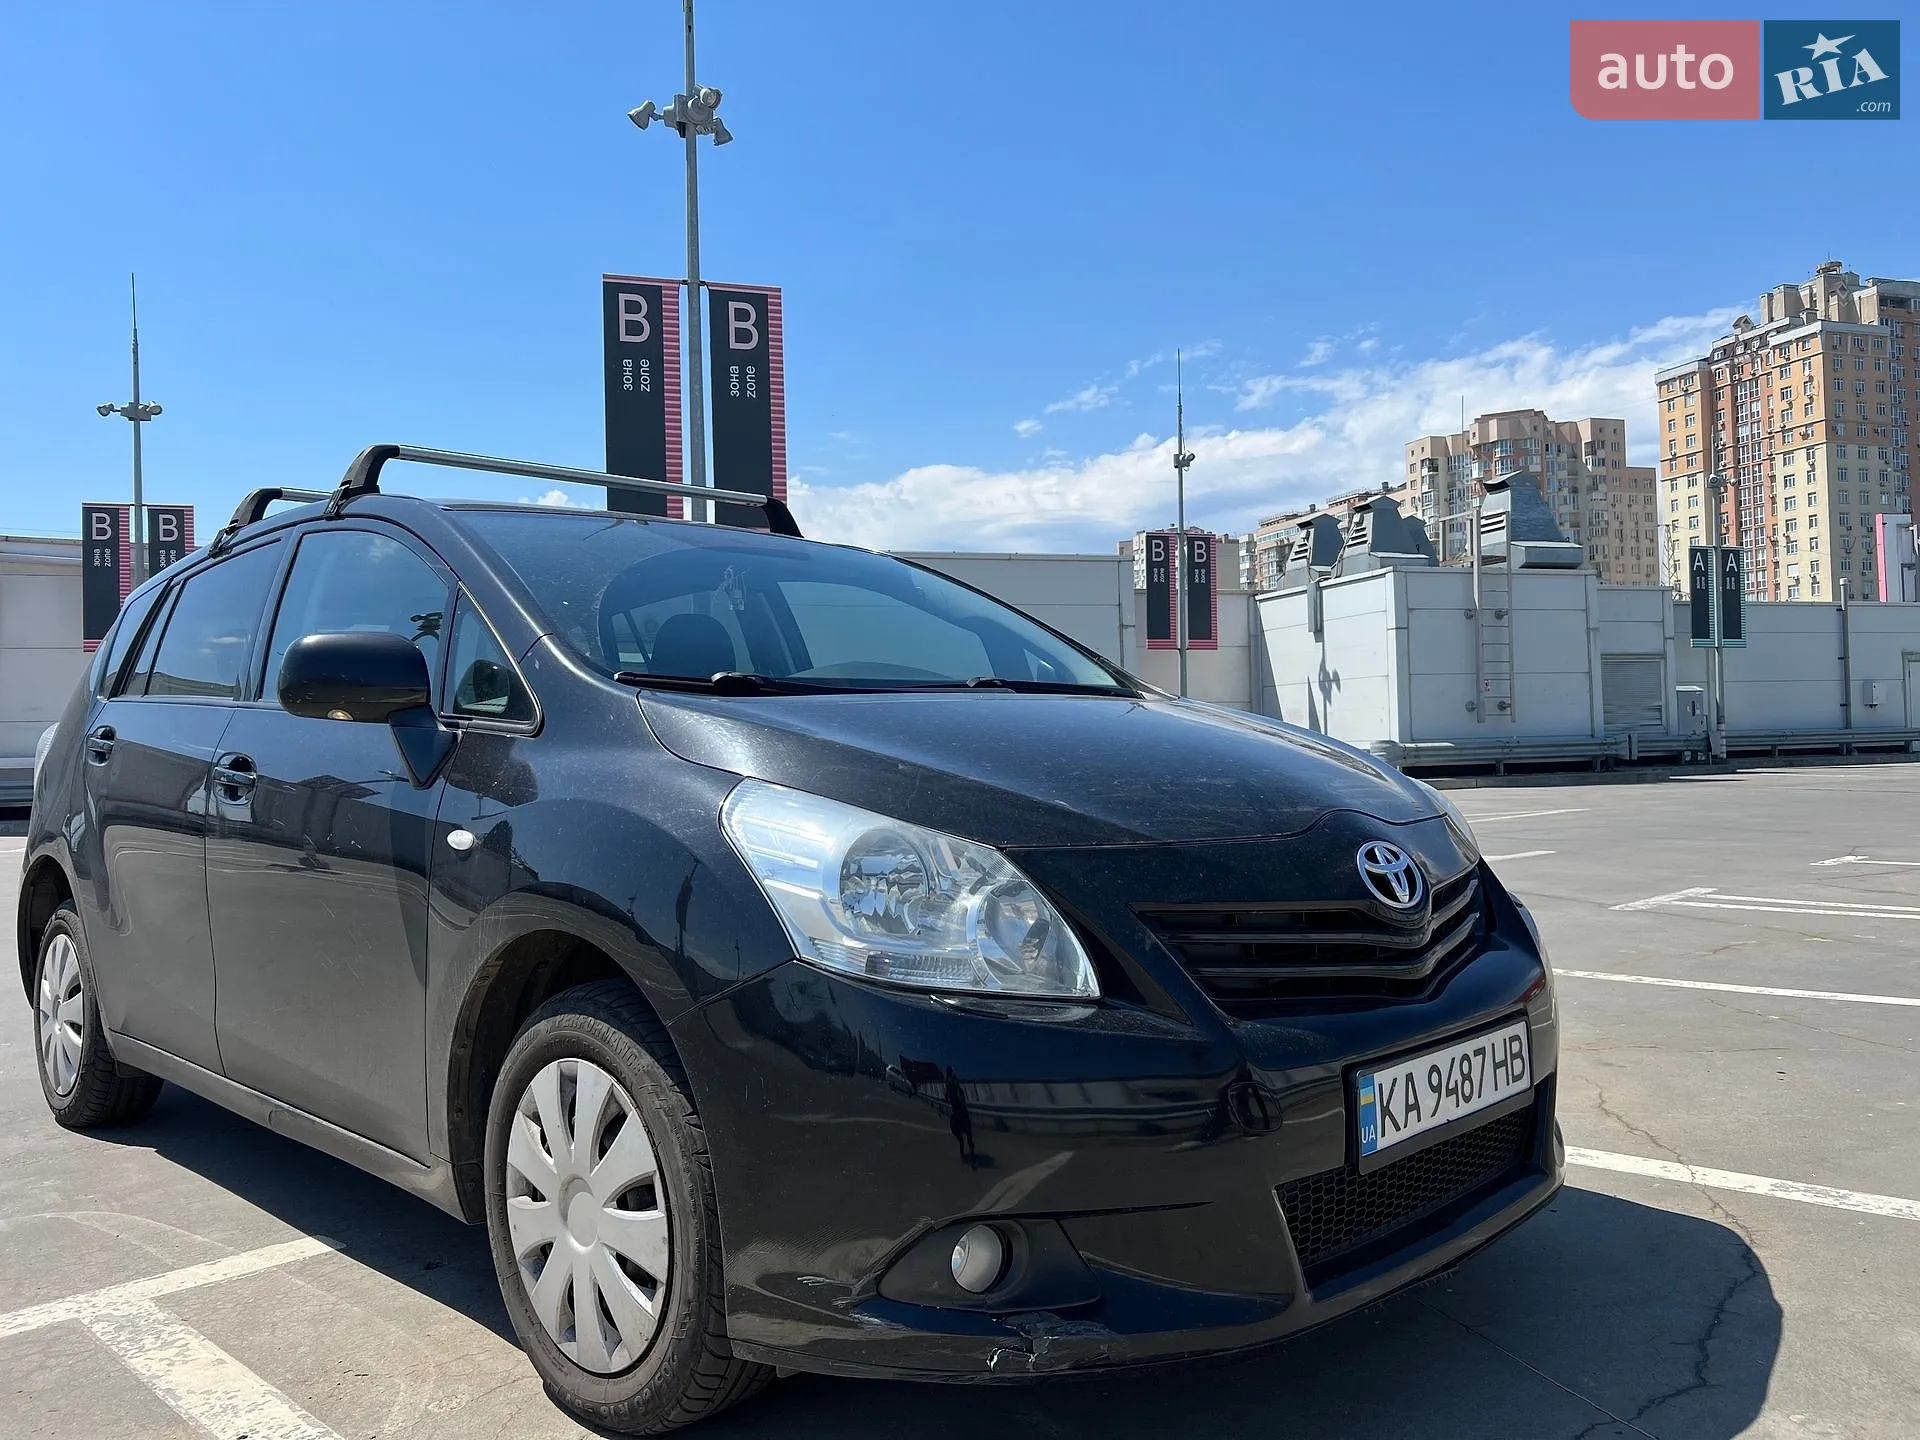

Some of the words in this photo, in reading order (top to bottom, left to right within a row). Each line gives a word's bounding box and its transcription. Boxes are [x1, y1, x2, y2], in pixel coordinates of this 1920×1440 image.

[618, 292, 651, 343] B
[728, 300, 759, 351] B
[623, 358, 633, 392] зона
[640, 358, 650, 393] zone
[730, 364, 740, 398] зона
[746, 365, 756, 399] zone
[91, 512, 112, 541] B
[158, 513, 179, 542] B
[93, 548, 101, 567] зона
[169, 549, 177, 565] one
[1152, 540, 1165, 561] B
[1194, 541, 1207, 562] B
[1693, 552, 1705, 571] A
[1726, 553, 1738, 572] A
[1378, 1071, 1422, 1138] KA
[1427, 1046, 1487, 1118] 9487
[1491, 1033, 1526, 1092] HB
[1361, 1123, 1376, 1144] UA
